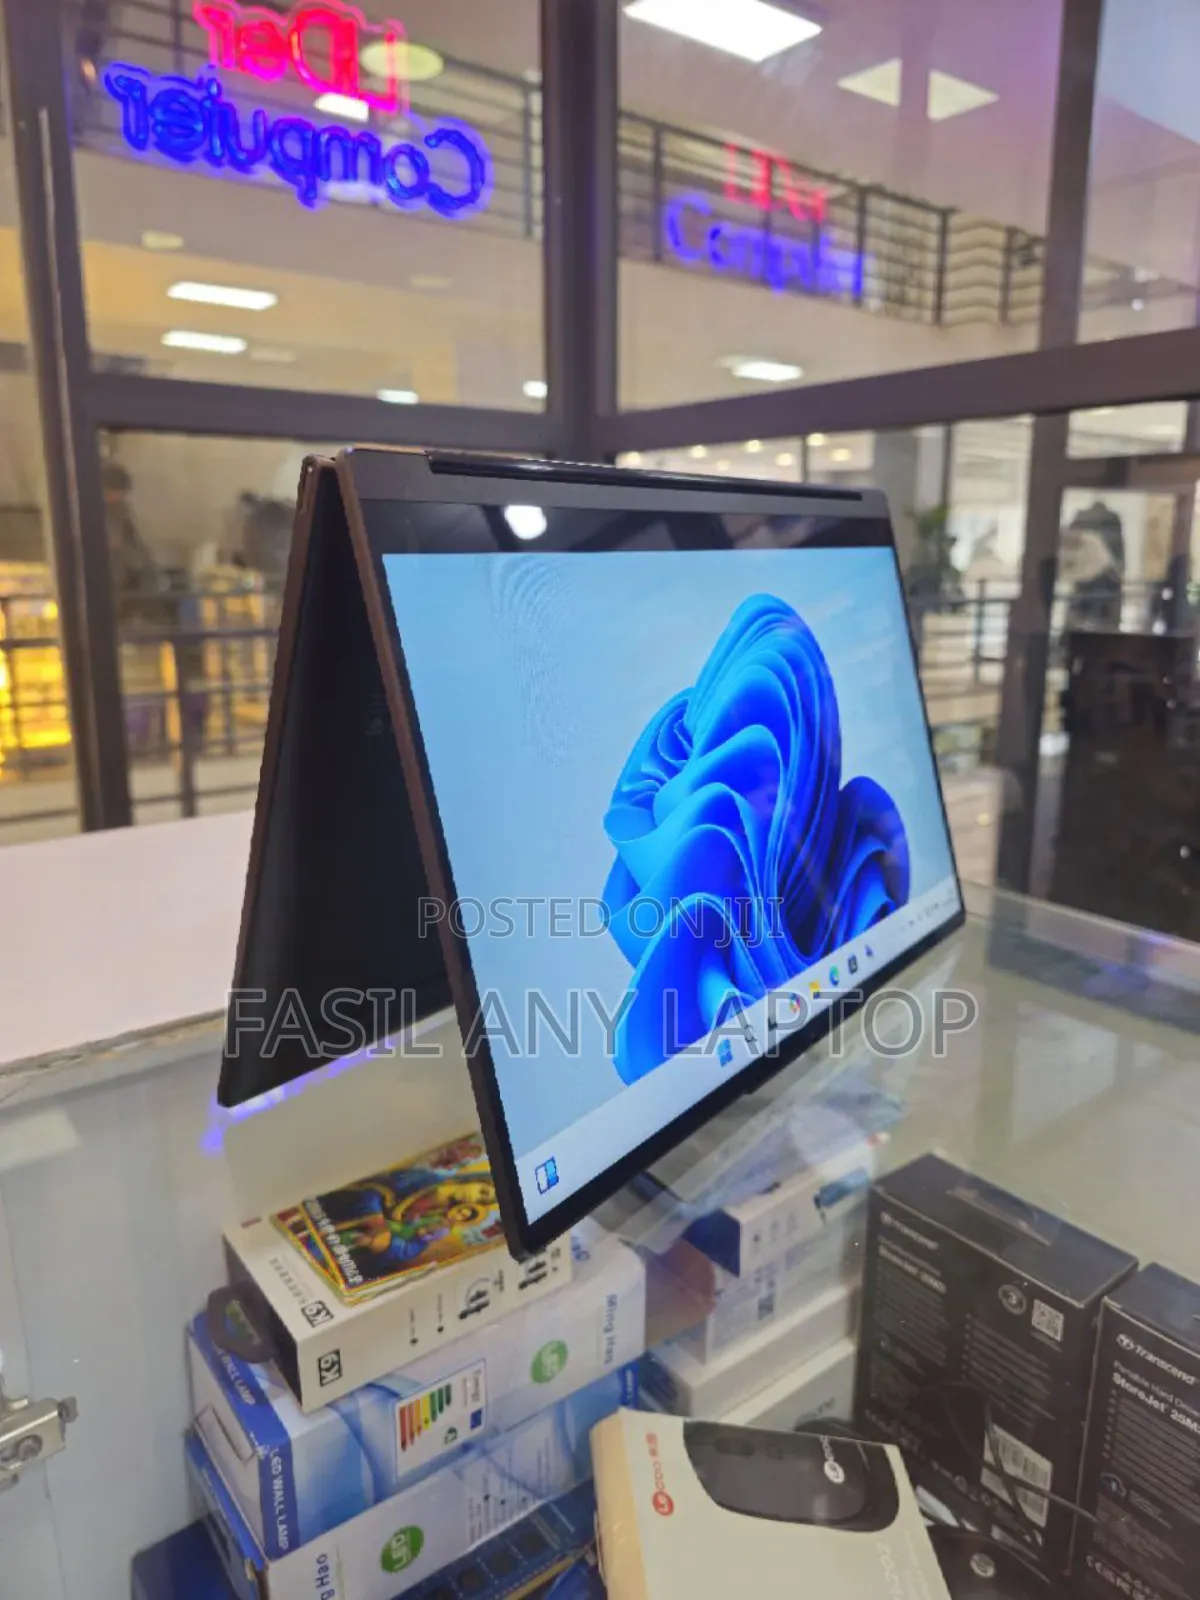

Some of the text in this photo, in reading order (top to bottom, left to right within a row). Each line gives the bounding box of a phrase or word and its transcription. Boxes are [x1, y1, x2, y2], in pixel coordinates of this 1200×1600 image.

[1134, 1344, 1196, 1386] Transcend
[1112, 1372, 1165, 1413] StoreJet
[270, 1447, 290, 1550] LED WALL LAMP
[315, 1553, 330, 1588] Hao
